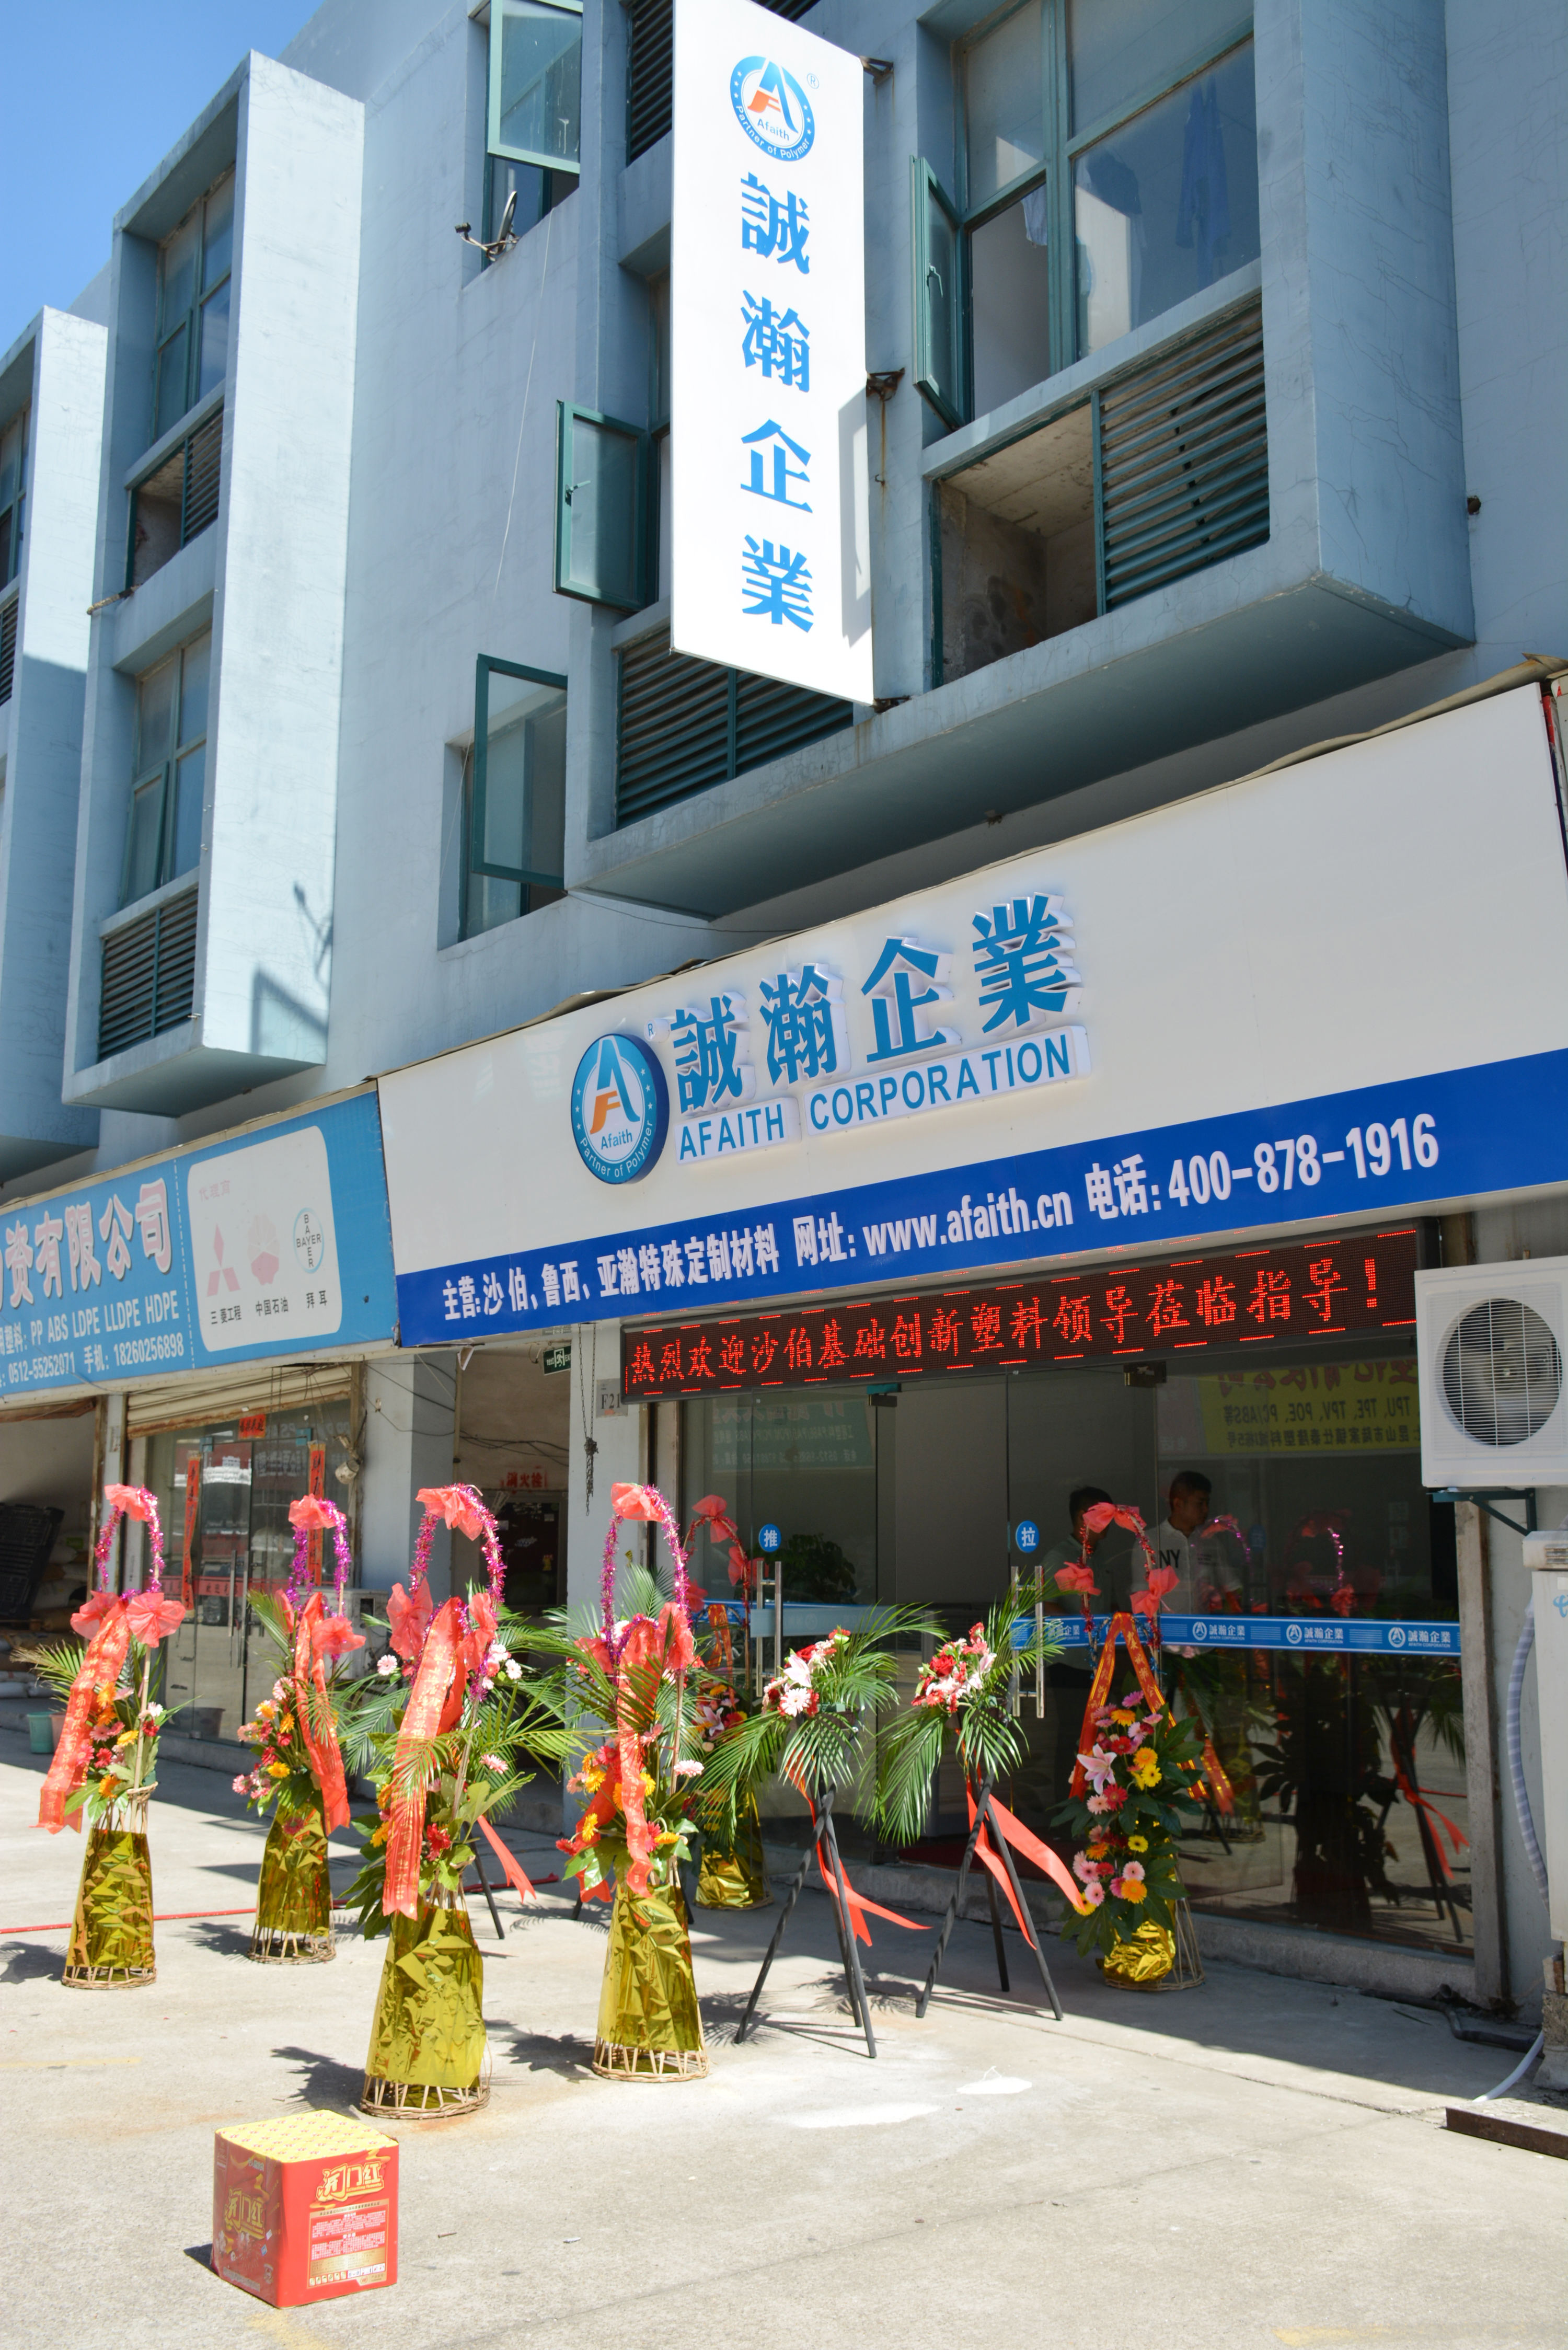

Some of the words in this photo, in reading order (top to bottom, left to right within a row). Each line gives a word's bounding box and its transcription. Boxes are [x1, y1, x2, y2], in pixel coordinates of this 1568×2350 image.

[736, 105, 764, 147] Partner
[767, 144, 777, 156] of
[780, 137, 810, 159] Polymer
[757, 118, 790, 141] Afaith
[740, 171, 814, 633] 誠瀚企業
[671, 892, 1075, 1115] 誠瀚企業
[679, 1103, 785, 1161] AFAITH
[810, 1034, 1070, 1131] CORPORATION
[580, 1137, 610, 1177] Partner
[615, 1165, 624, 1178] of
[626, 1120, 653, 1173] Polymer
[601, 1129, 632, 1149] Afaith
[862, 1187, 1074, 1256] www.afaith.cn
[1168, 1113, 1439, 1207] 400-878-1916
[0, 1178, 173, 1311] 资有限公司
[296, 1234, 321, 1248] BAYER
[30, 1320, 43, 1345] PP
[48, 1314, 68, 1343] ABS
[72, 1307, 100, 1339] LDPE
[104, 1298, 141, 1332] LLDPE
[145, 1290, 180, 1324] HDPE
[256, 1297, 289, 1317] 中国石油
[113, 1332, 185, 1366] 18260256898
[601, 1393, 620, 1410] F21
[506, 1470, 544, 1490] 消火栓
[764, 1529, 777, 1548] 推
[1021, 1527, 1036, 1547] 拉
